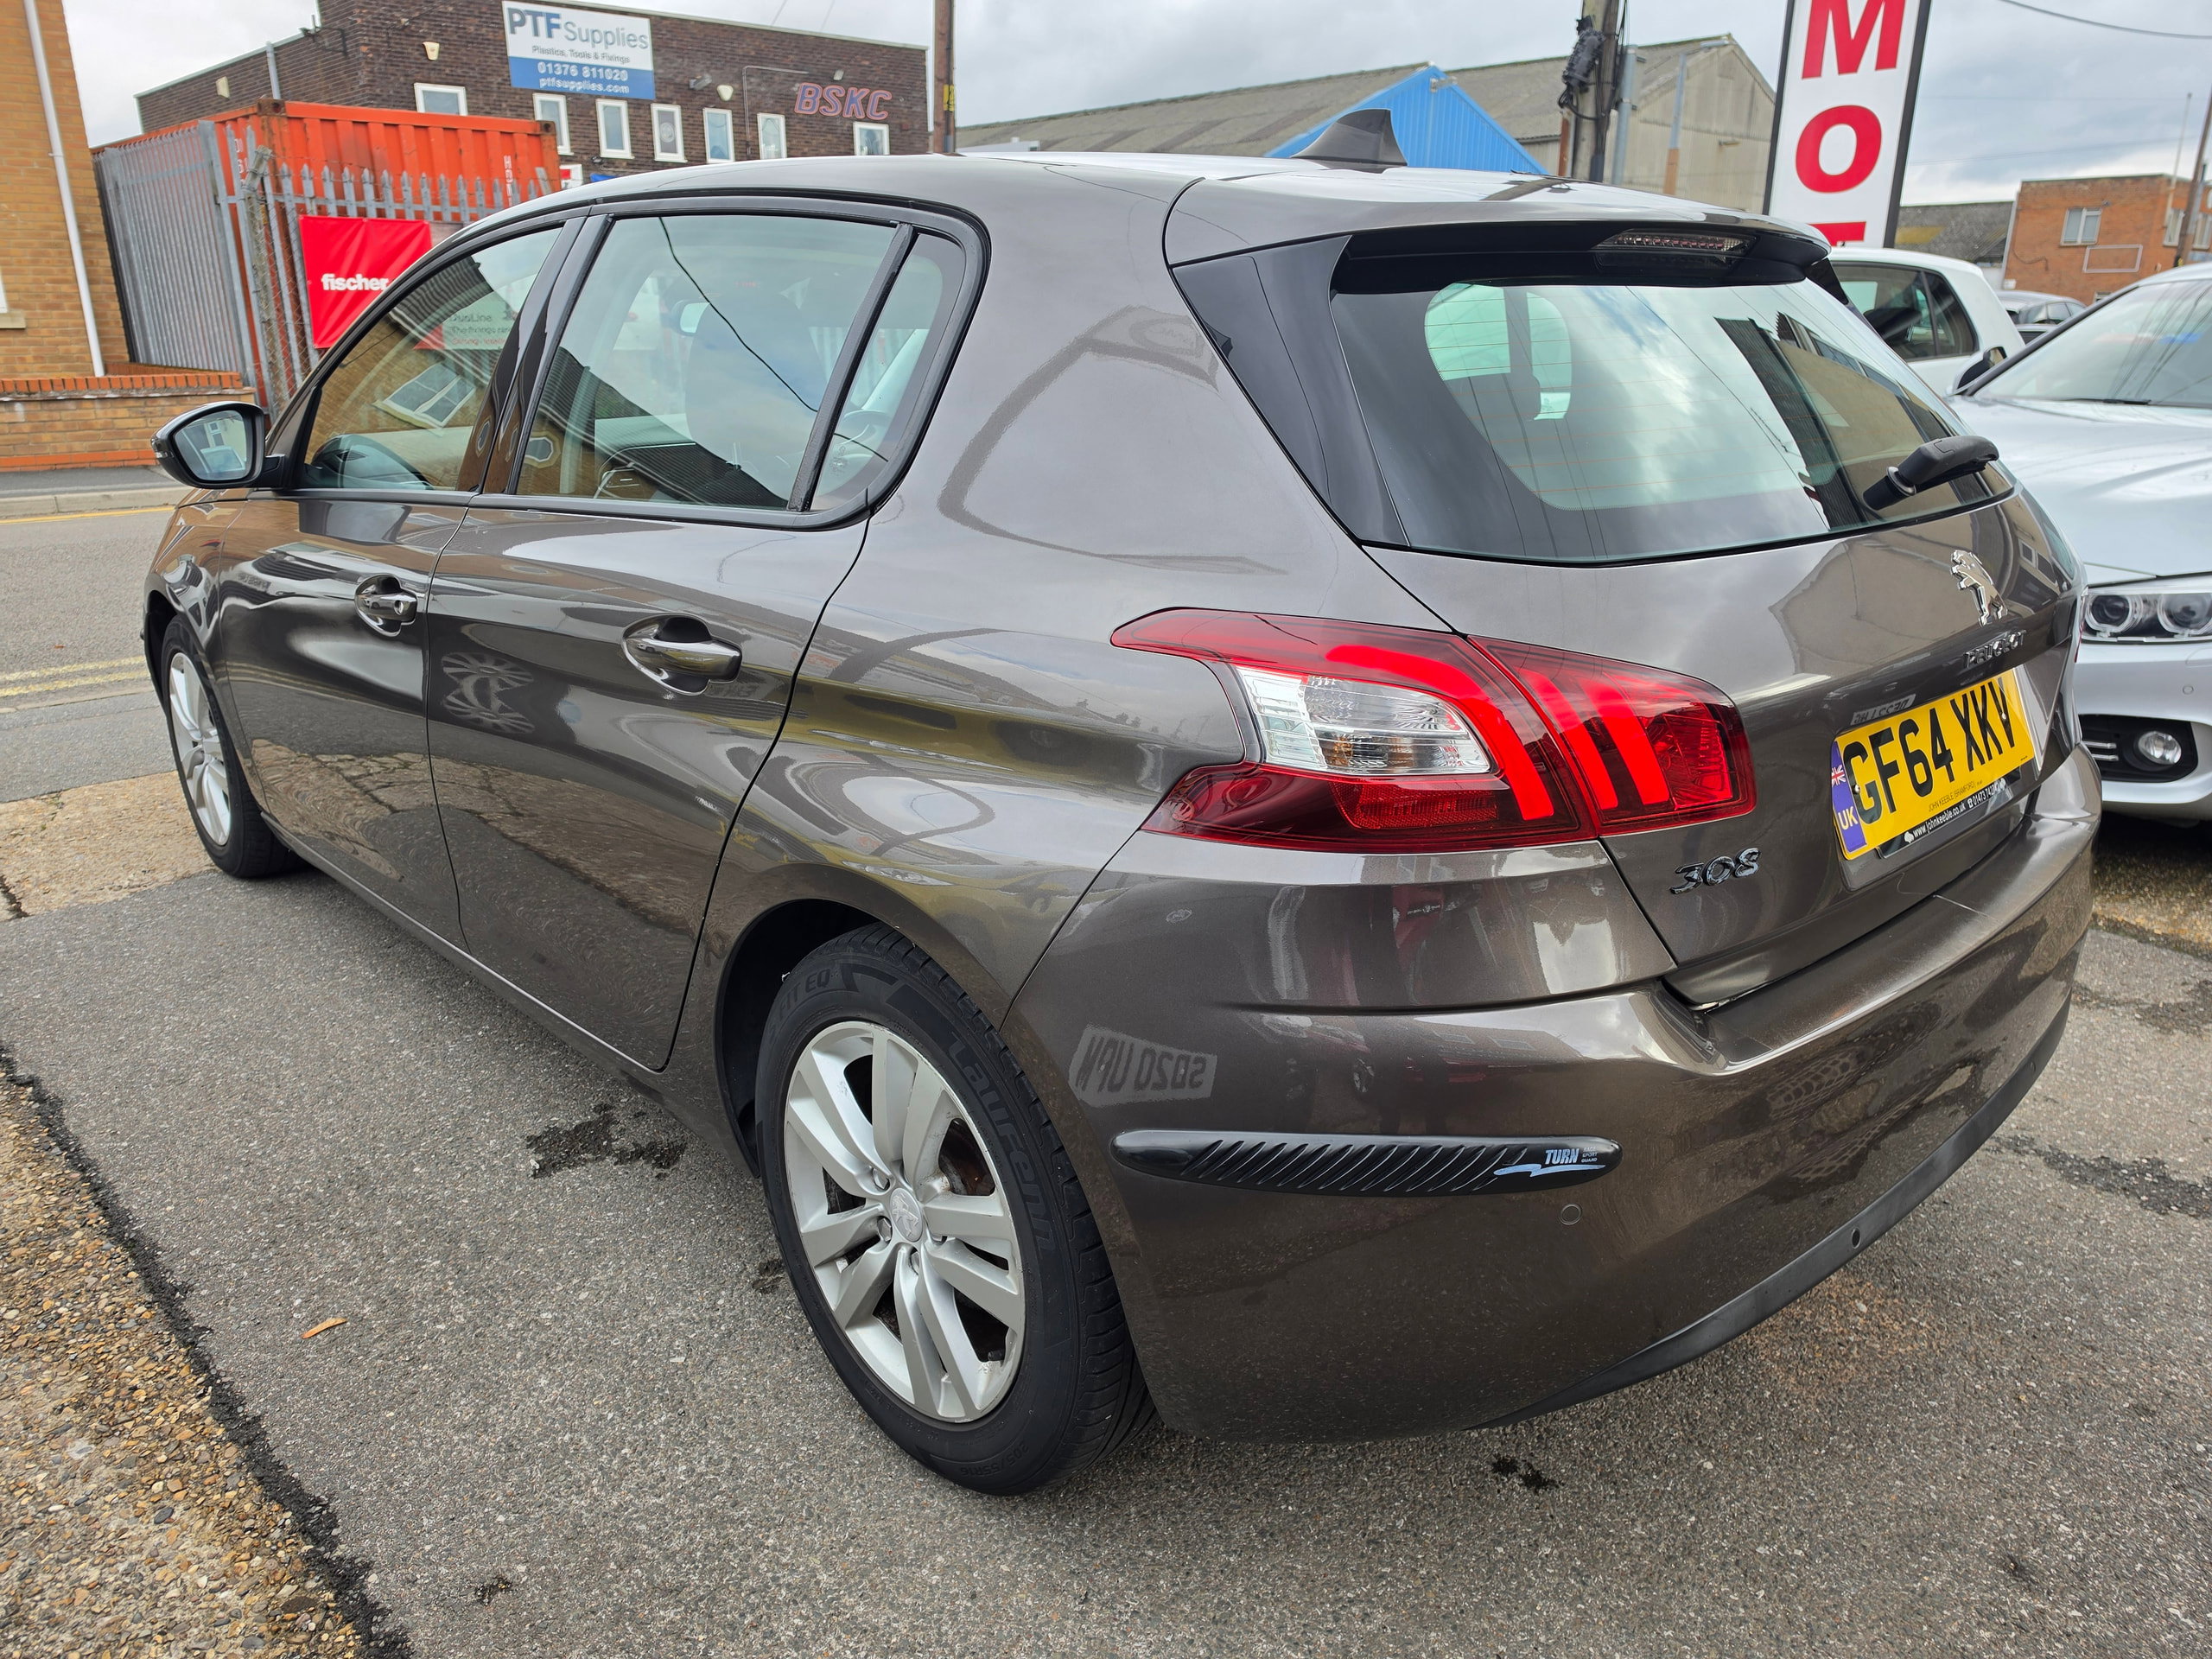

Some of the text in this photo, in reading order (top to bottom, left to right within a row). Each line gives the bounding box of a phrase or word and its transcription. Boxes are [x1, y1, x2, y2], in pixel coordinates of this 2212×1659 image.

[507, 7, 648, 49] PTF Supplies
[537, 61, 628, 81] 01376 811020
[569, 49, 591, 60] Tools
[594, 52, 600, 60] &
[601, 52, 631, 64] Fixings
[539, 77, 630, 94] ptfsupplies.com
[794, 82, 893, 120] BSKC
[1796, 0, 1905, 247] MO
[321, 273, 389, 291] fischer
[1842, 677, 2015, 824] GF64 XKV
[1838, 805, 1859, 830] UK
[1913, 800, 1966, 839] www.johnkeeble.co.uk
[1669, 848, 1761, 895] 308
[805, 969, 830, 993] EQ
[949, 1035, 1056, 1251] Laufenn
[1545, 1147, 1580, 1165] TURN
[960, 1440, 1029, 1477] 205/55R16
